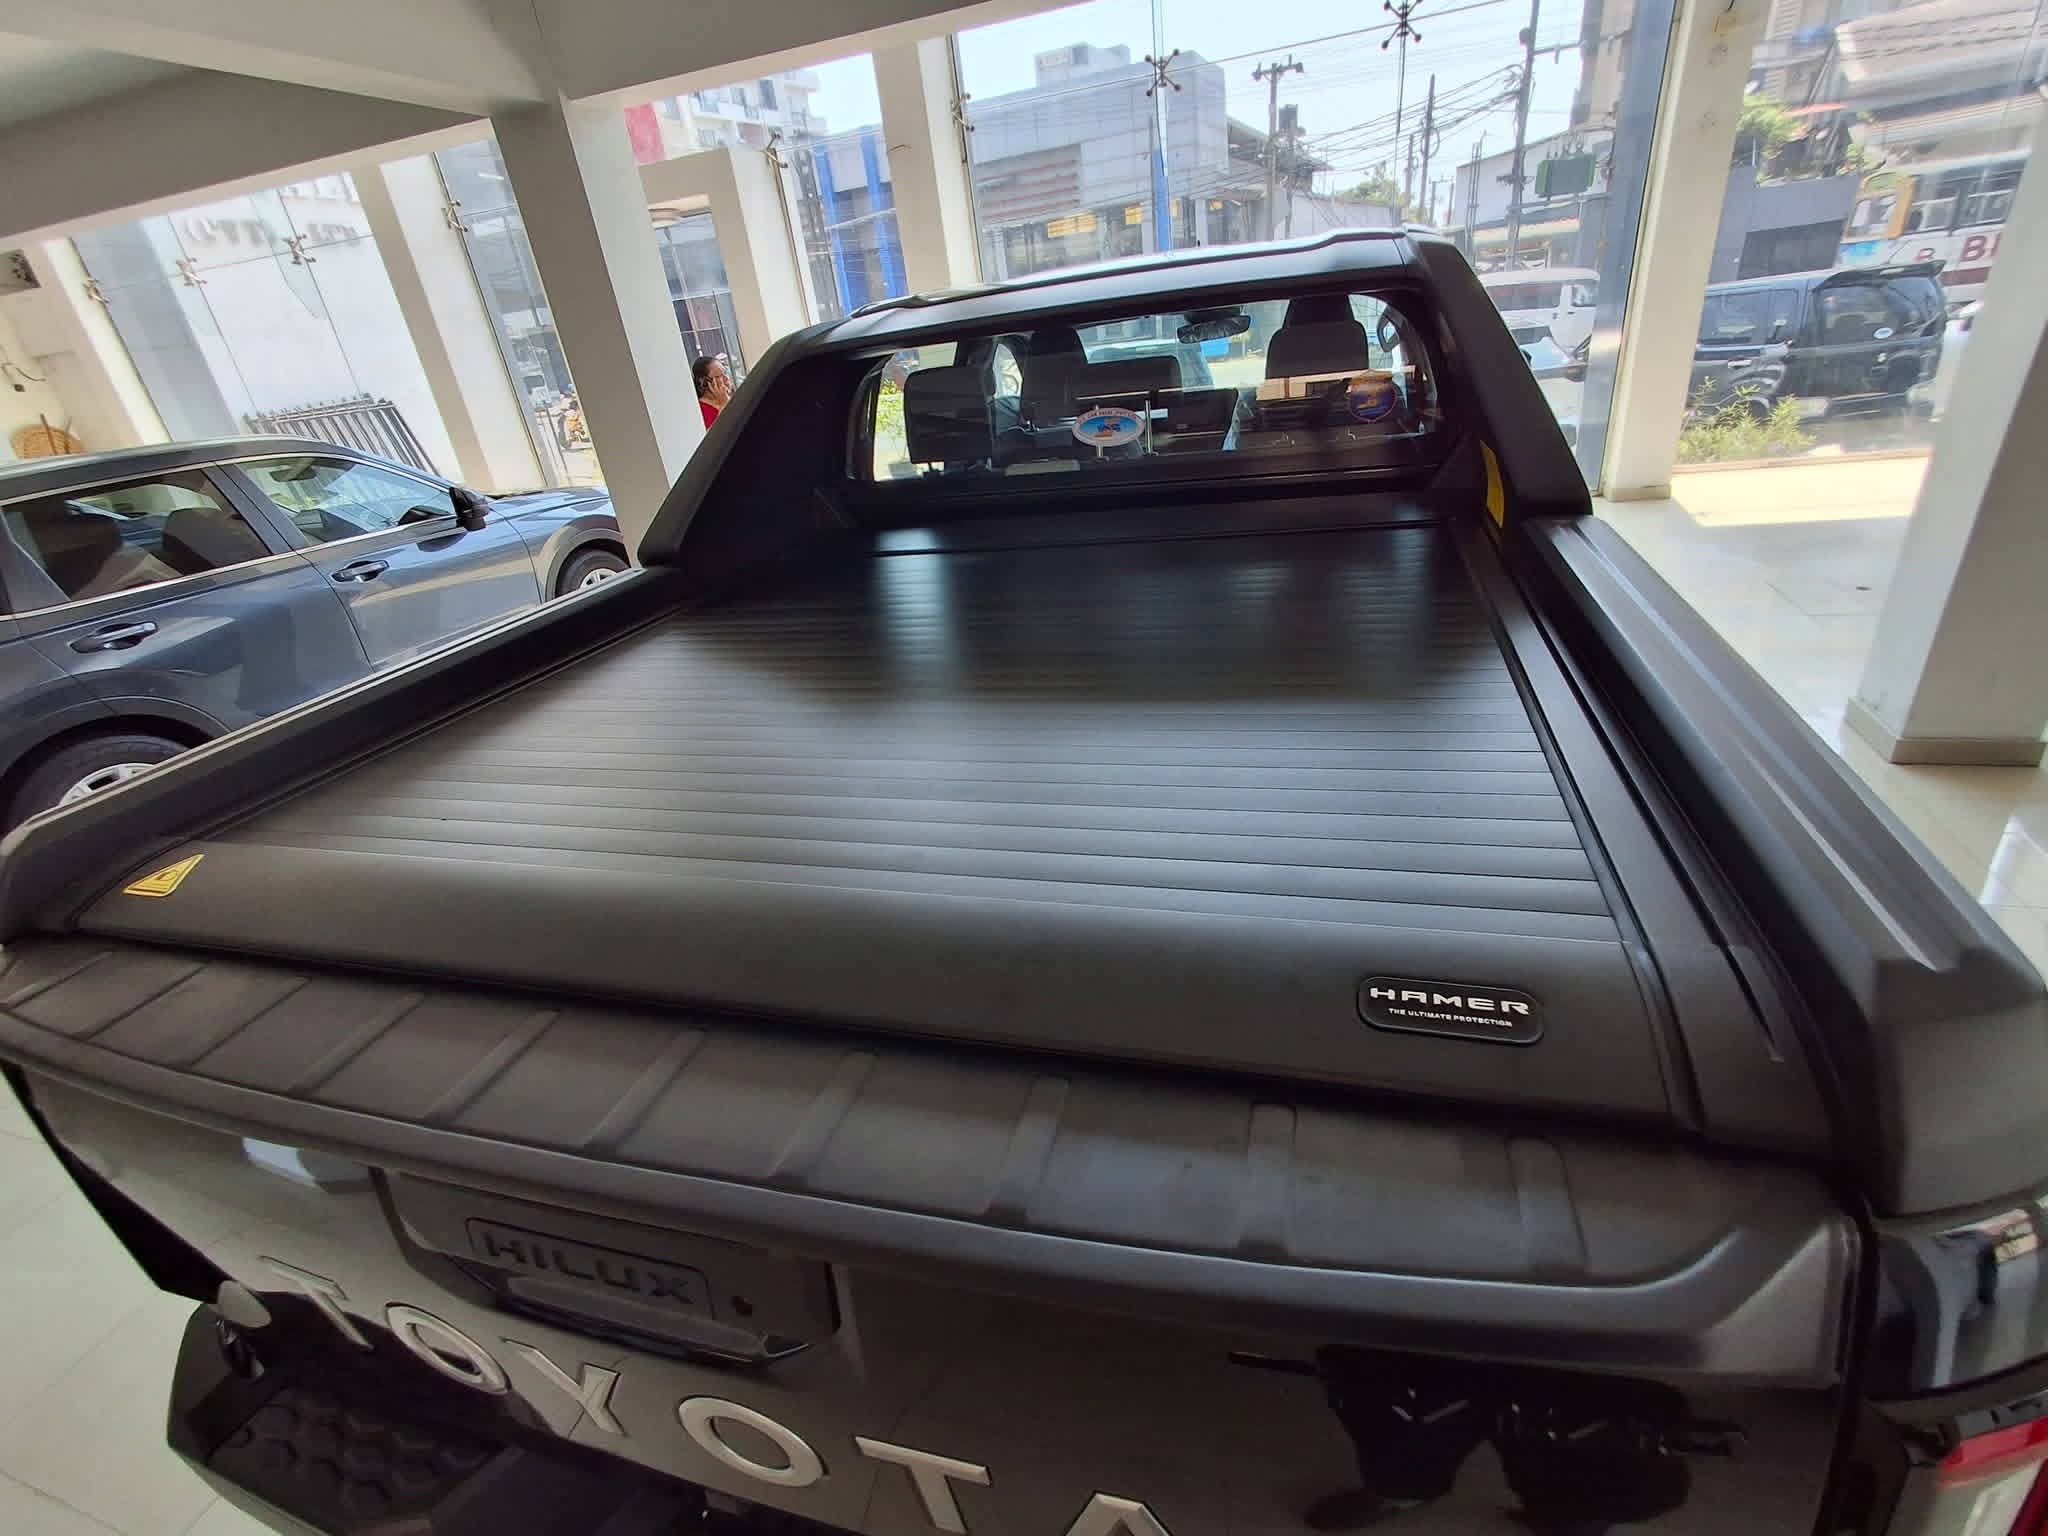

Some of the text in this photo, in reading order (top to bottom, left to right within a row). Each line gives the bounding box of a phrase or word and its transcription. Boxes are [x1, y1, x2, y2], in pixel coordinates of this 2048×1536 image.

[1369, 987, 1530, 1015] HAMER
[1388, 1008, 1513, 1028] THE ULTIMATE PROTECTION
[483, 1231, 696, 1305] HILUX
